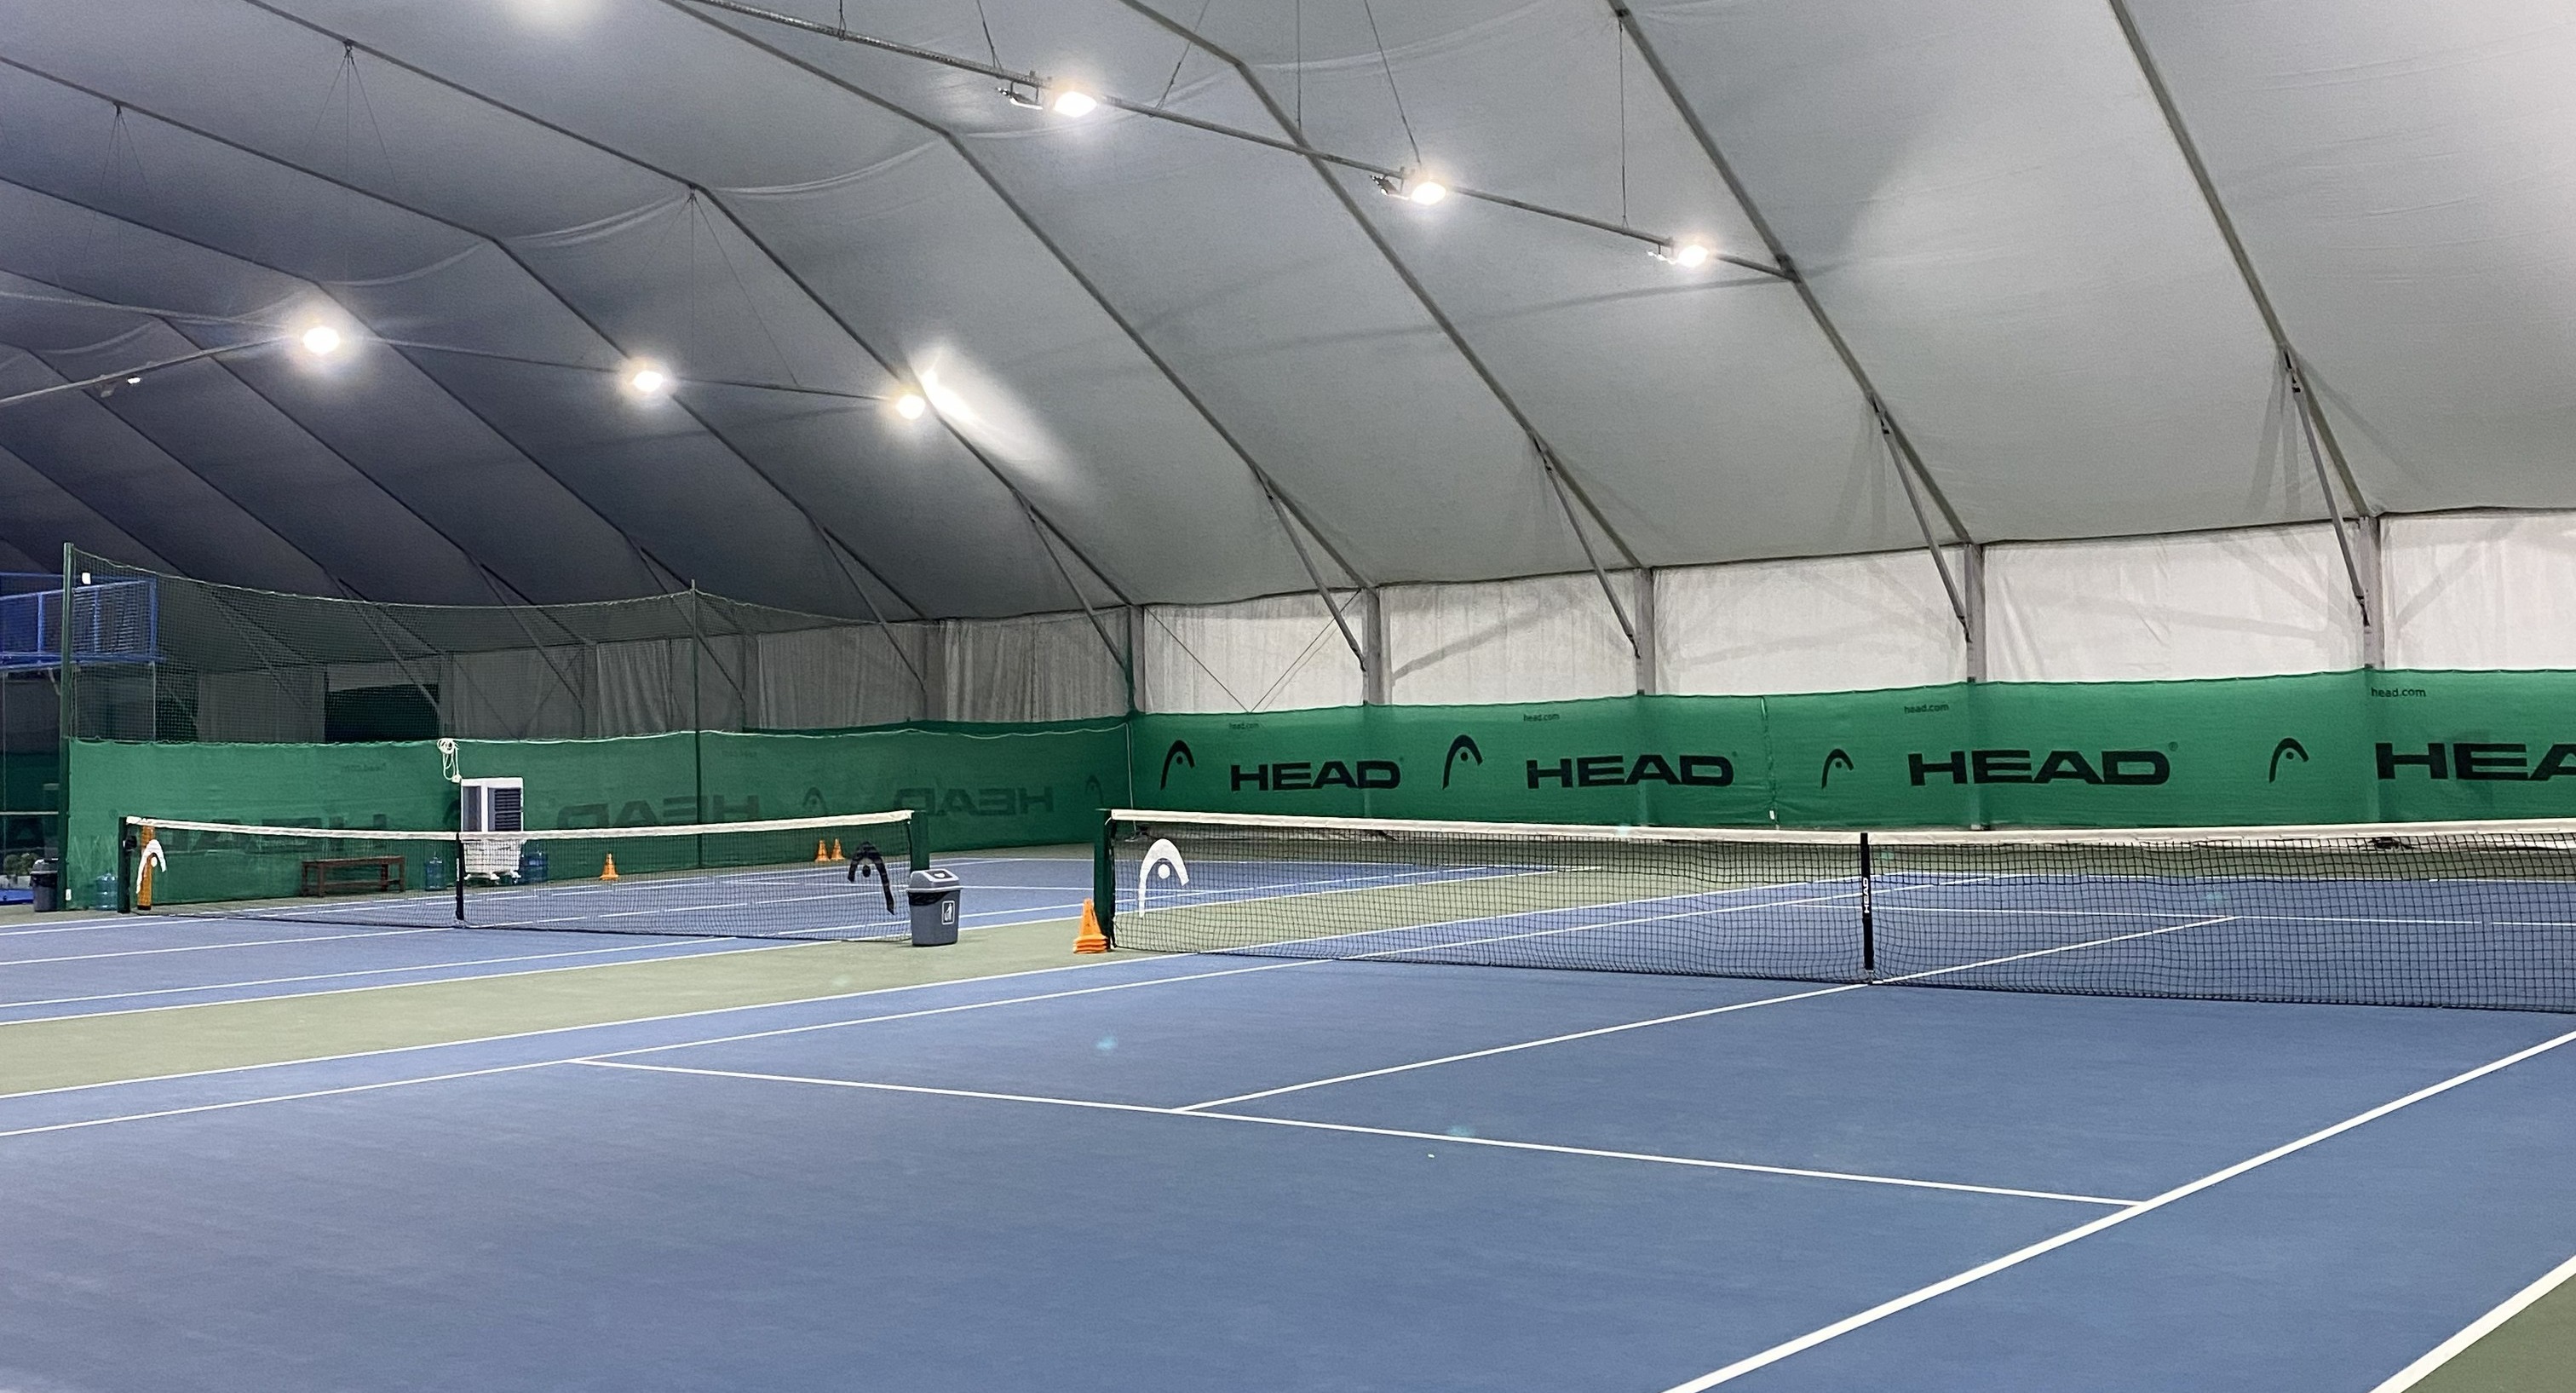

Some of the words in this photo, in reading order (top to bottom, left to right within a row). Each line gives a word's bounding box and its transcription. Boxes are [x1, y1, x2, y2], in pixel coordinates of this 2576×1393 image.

[2371, 687, 2427, 698] head.com
[1523, 712, 1560, 722] head.com
[1904, 703, 1950, 714] head.com
[1231, 760, 1400, 791] HEAD
[1527, 754, 1734, 789] HEAD
[1908, 750, 2171, 786] HEAD
